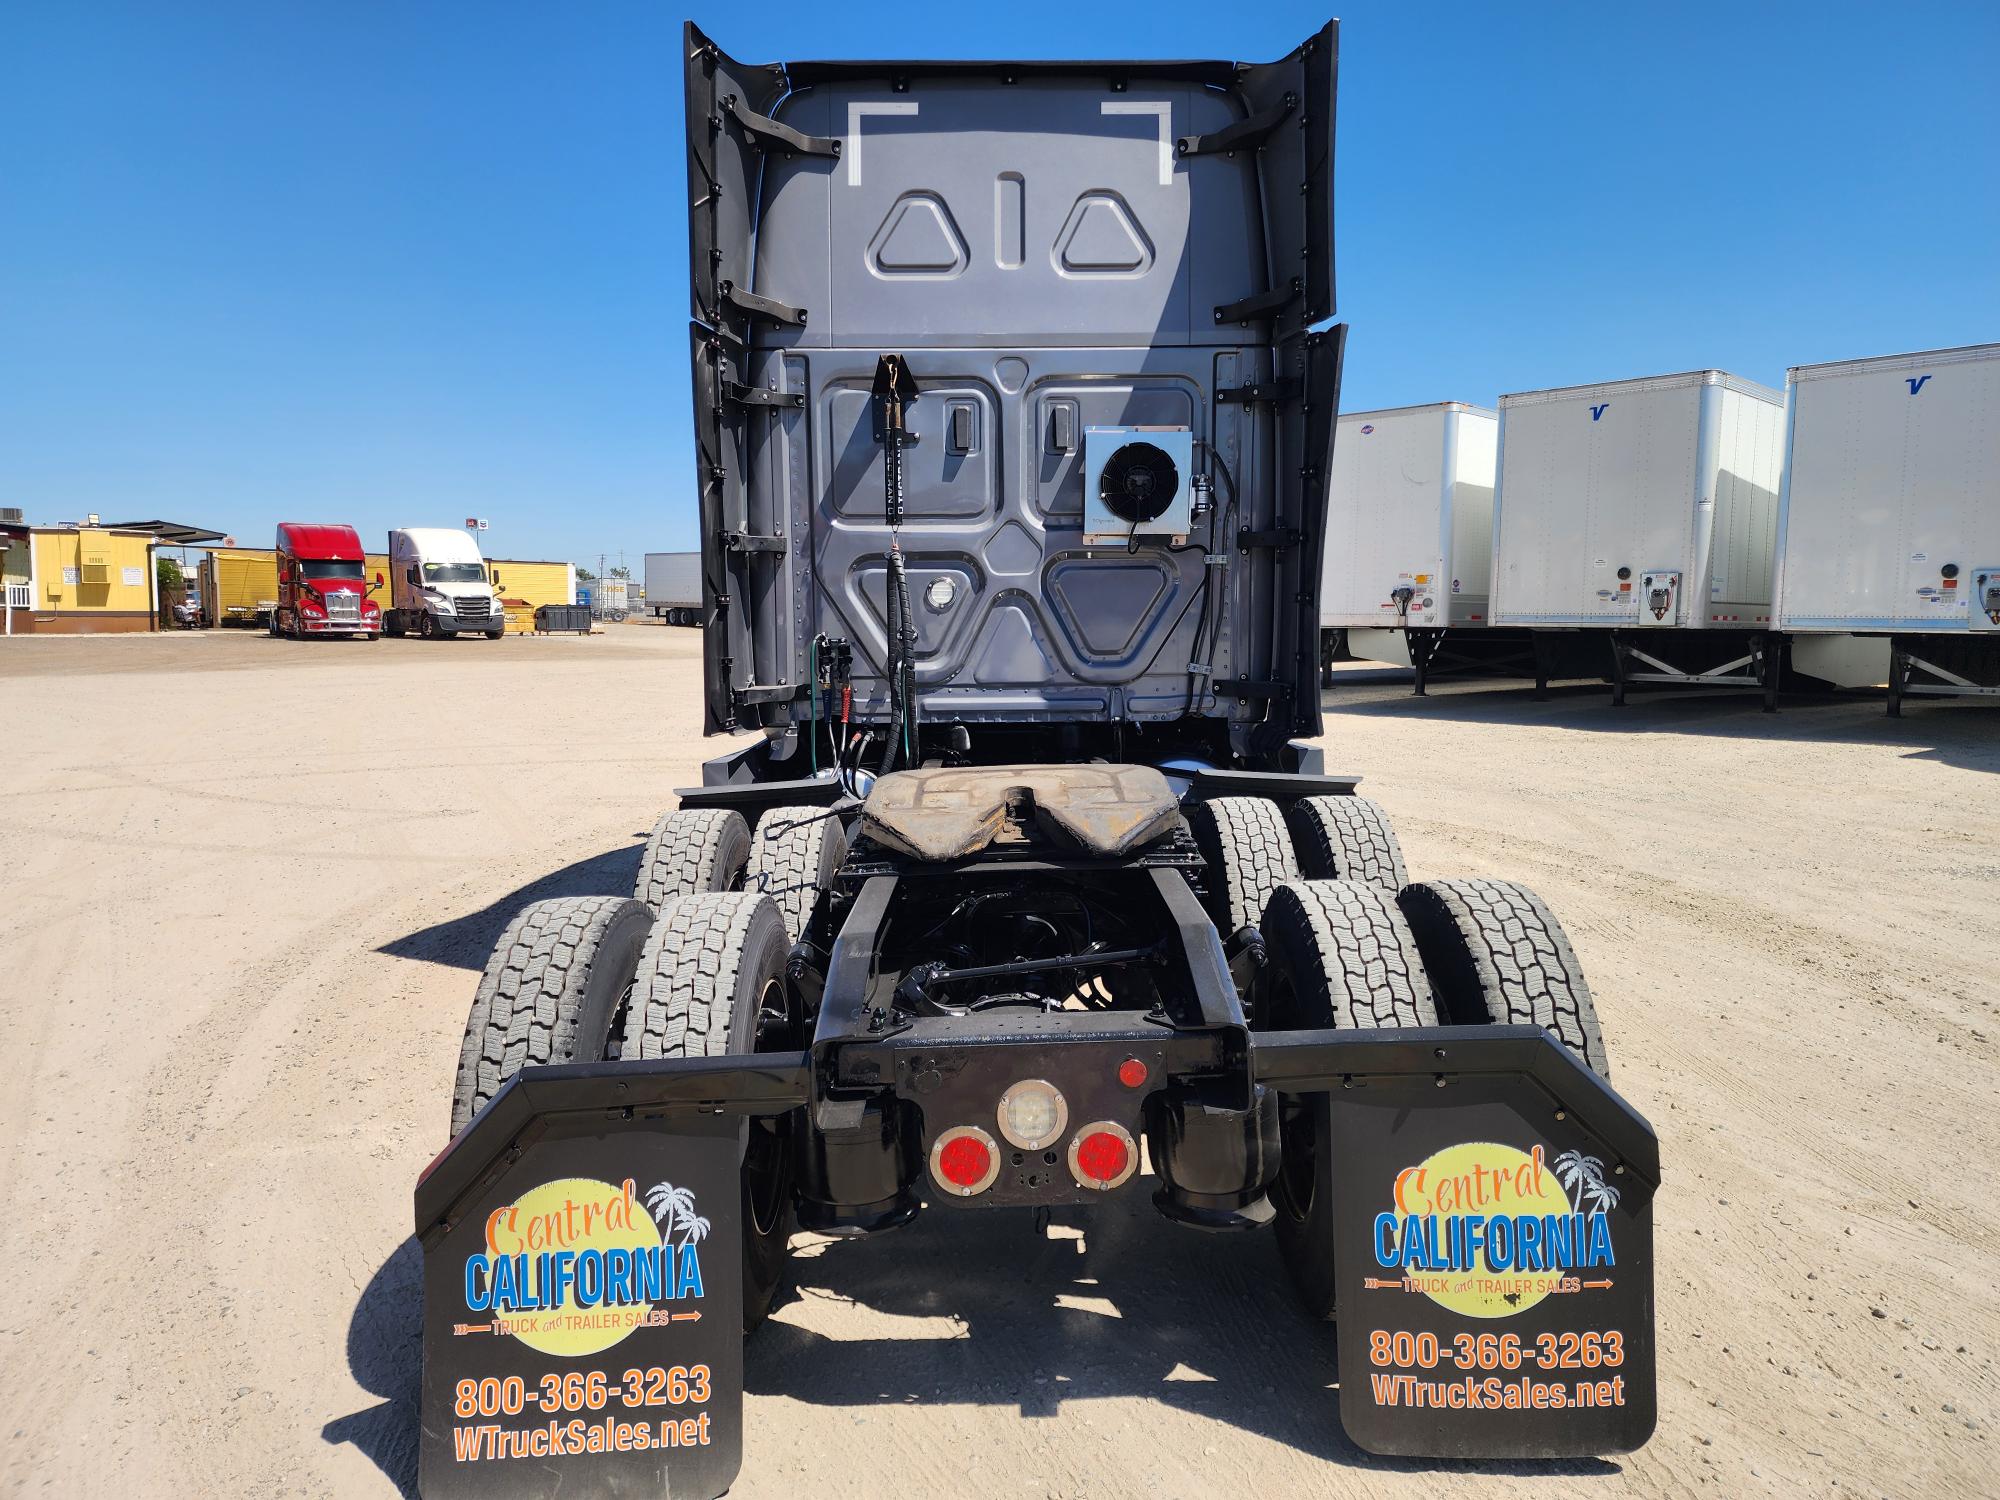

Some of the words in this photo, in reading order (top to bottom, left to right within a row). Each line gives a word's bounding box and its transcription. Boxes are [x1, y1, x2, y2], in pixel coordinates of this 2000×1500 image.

[1394, 1144, 1549, 1219] Central
[485, 1178, 639, 1259] Central
[1374, 1211, 1616, 1273] CALIFORNIA
[465, 1243, 705, 1313] CALIFORNIA
[1402, 1277, 1449, 1293] TRUCK
[1453, 1276, 1474, 1294] and
[1476, 1278, 1533, 1294] TRAILER
[1536, 1277, 1581, 1294] SALES
[491, 1318, 538, 1335] TRUCK
[541, 1314, 563, 1333] and
[564, 1315, 621, 1331] TRAILER
[624, 1310, 669, 1327] SALES
[1369, 1330, 1624, 1370] 800-366-3263
[455, 1364, 711, 1418] 800-366-3263
[1370, 1374, 1625, 1410] WTruckSales.net
[454, 1411, 711, 1462] WTruckSales.net
